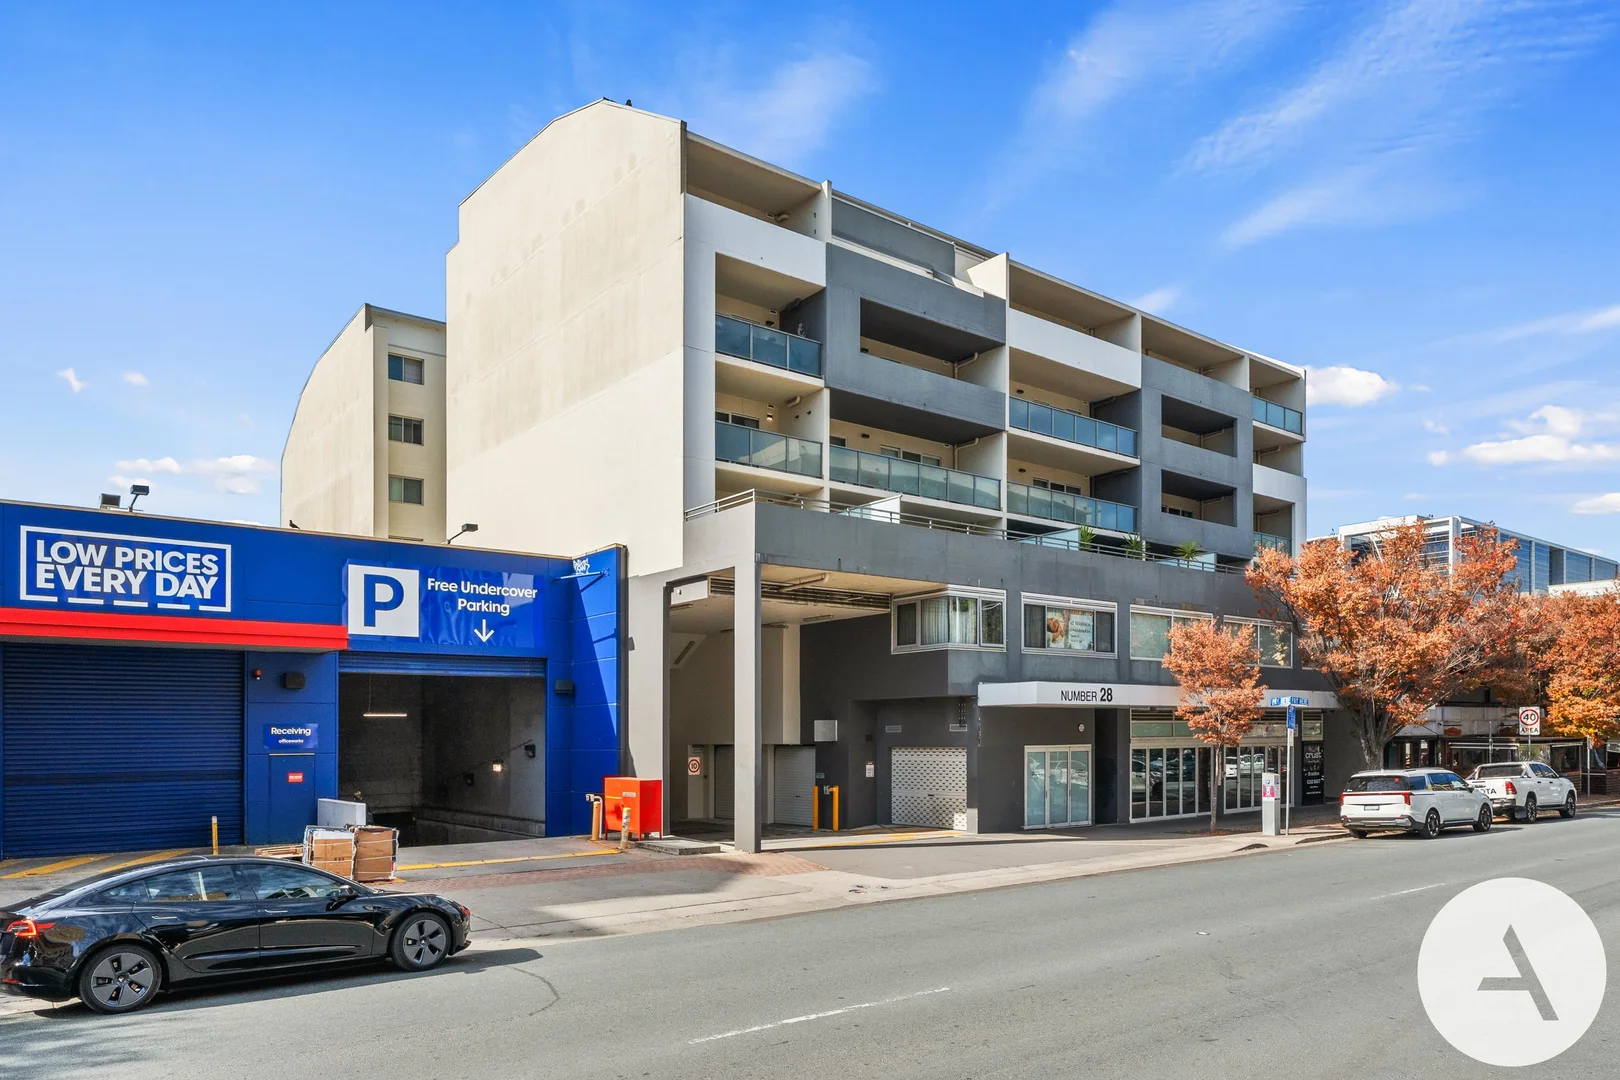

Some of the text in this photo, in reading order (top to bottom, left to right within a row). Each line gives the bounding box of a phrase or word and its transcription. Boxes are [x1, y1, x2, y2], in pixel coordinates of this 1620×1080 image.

[36, 539, 219, 575] LOW PRICES
[36, 563, 219, 599] EVERY DAY
[427, 577, 538, 599] Free Undercover
[364, 573, 405, 628] P
[457, 598, 510, 616] Parking
[1060, 687, 1113, 702] NUMBER 28
[1523, 713, 1536, 721] 40
[271, 727, 312, 737] Receiving
[690, 762, 698, 770] 10
